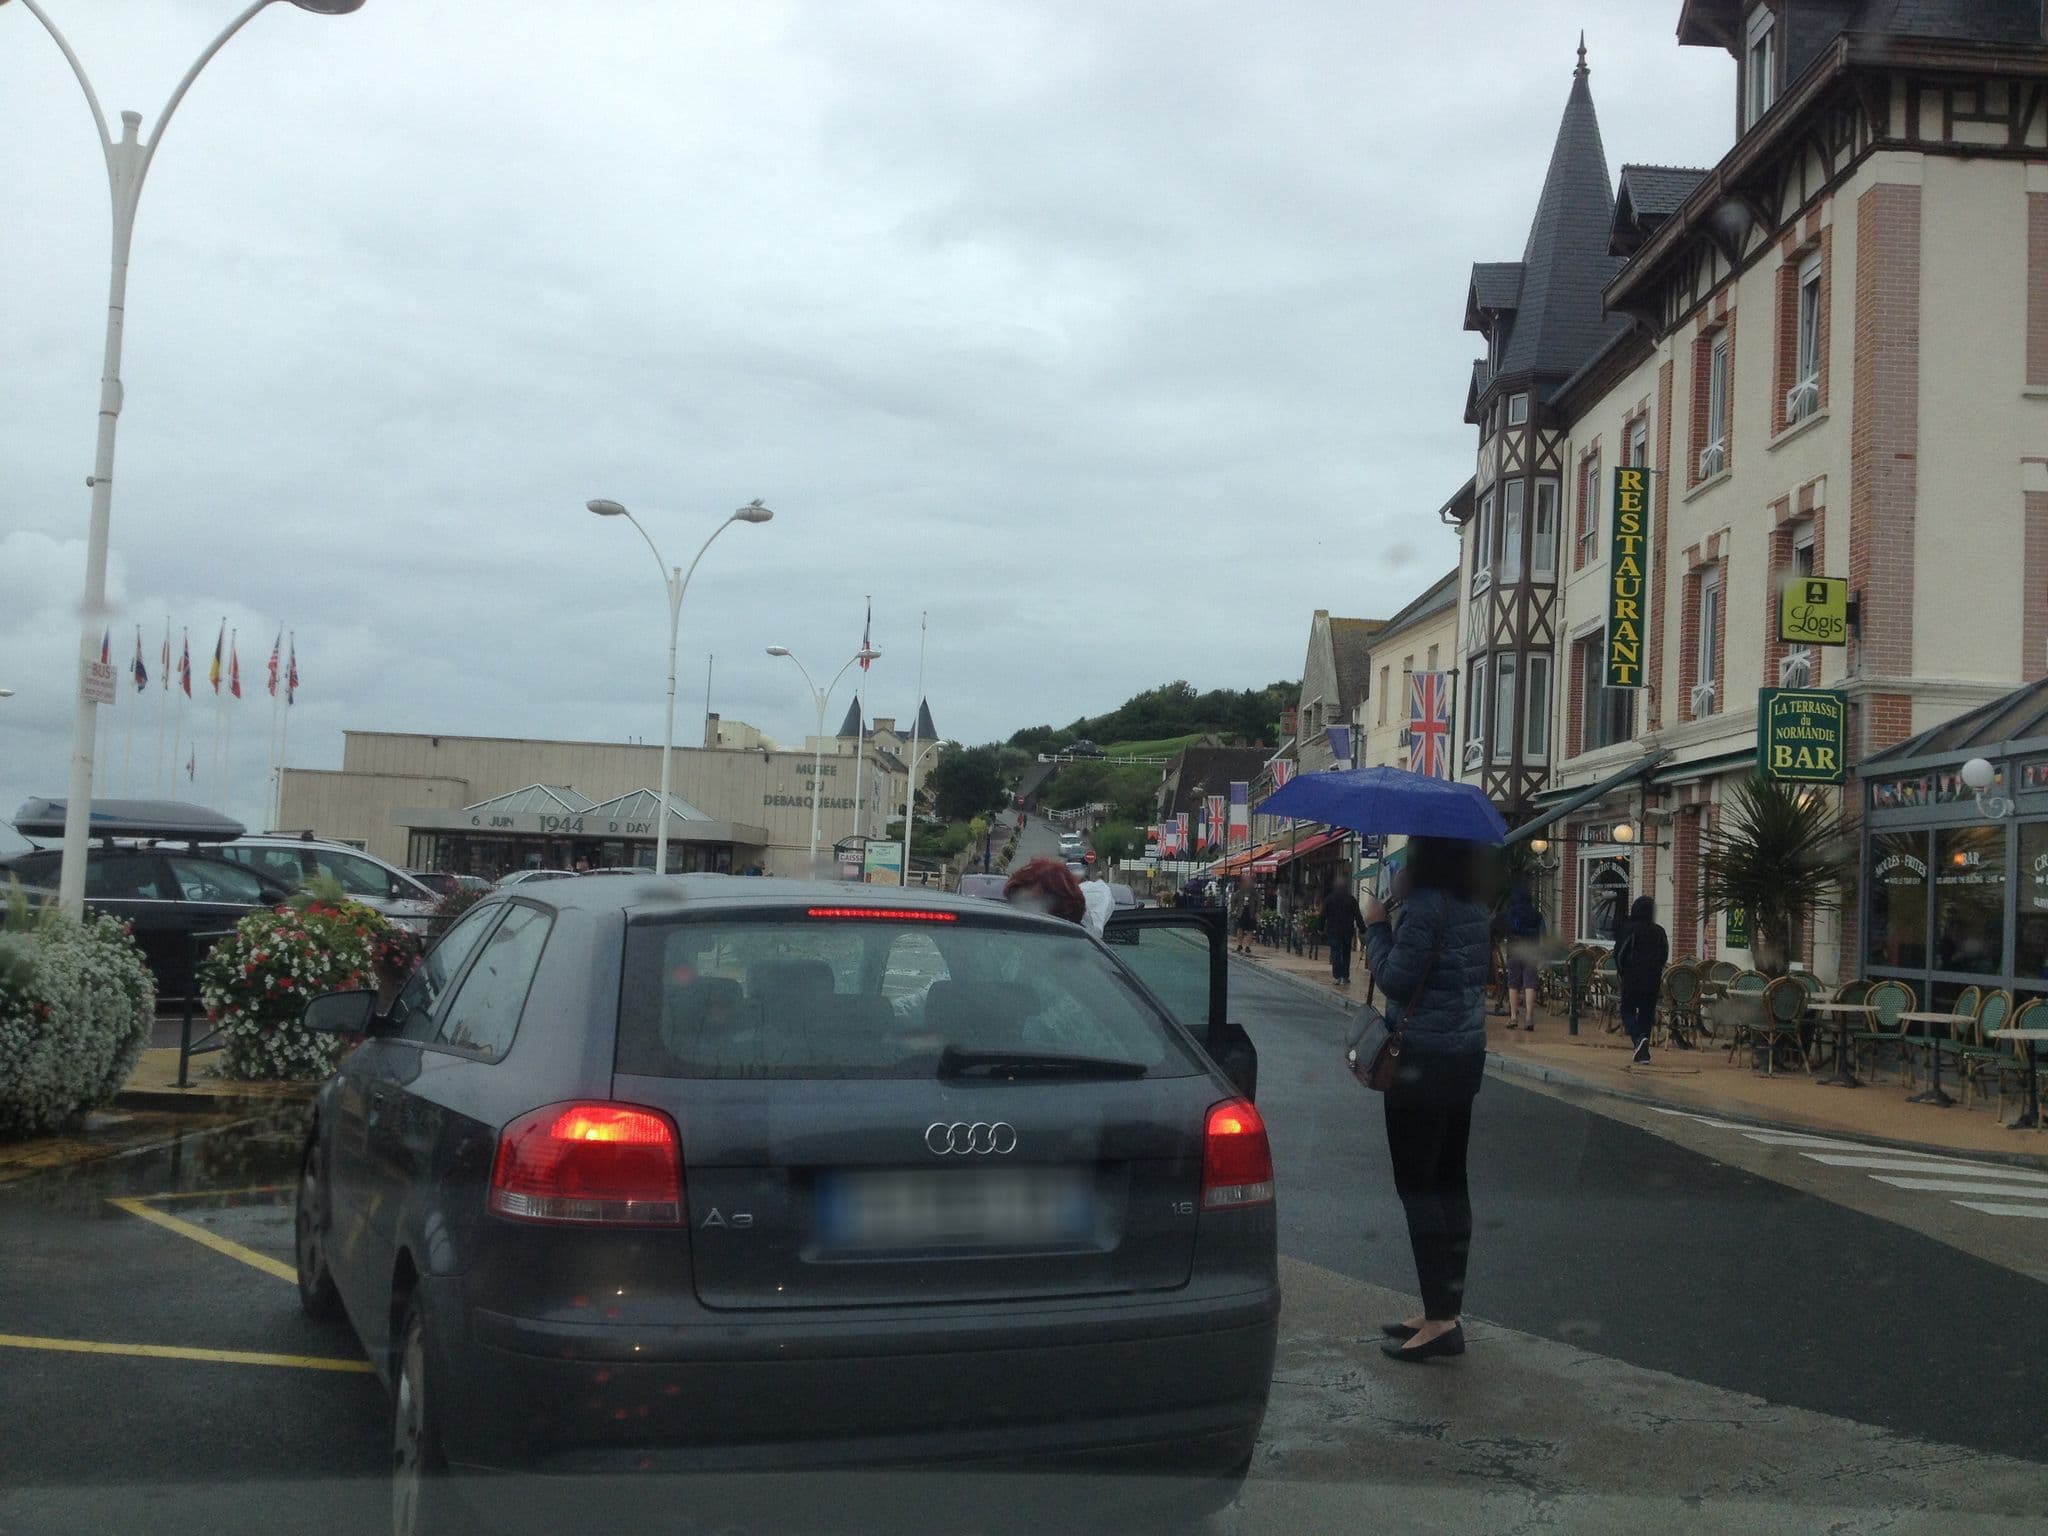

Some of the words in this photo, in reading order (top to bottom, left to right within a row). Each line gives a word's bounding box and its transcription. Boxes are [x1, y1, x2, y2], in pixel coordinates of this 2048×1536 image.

[1611, 470, 1644, 684] RESTAURANT
[1788, 604, 1843, 638] Logis
[92, 661, 110, 679] BUS
[1775, 702, 1788, 716] LA
[1790, 700, 1837, 718] TERRASSE
[1800, 714, 1811, 726] du
[1776, 727, 1835, 741] NORMANDIE
[1774, 745, 1836, 770] BAR
[471, 815, 481, 826] 6
[488, 815, 514, 828] JUIN
[538, 815, 584, 833] 1944
[609, 821, 618, 832] D
[626, 822, 651, 834] DAY
[700, 1207, 753, 1229] A3
